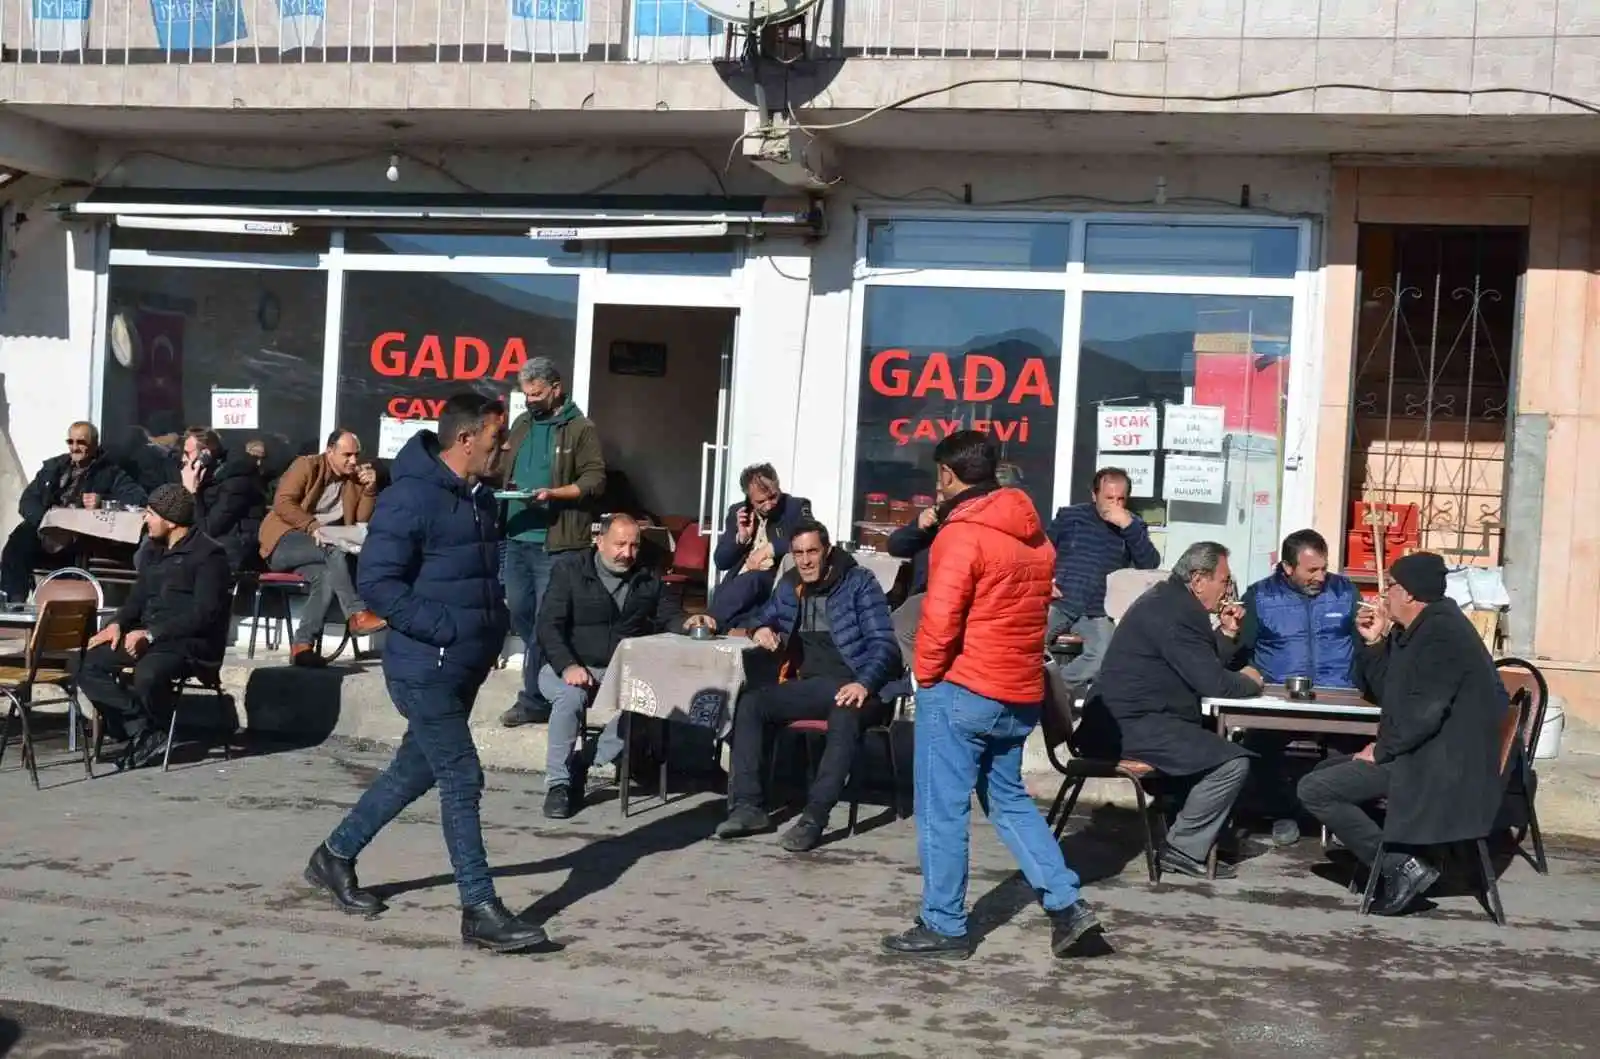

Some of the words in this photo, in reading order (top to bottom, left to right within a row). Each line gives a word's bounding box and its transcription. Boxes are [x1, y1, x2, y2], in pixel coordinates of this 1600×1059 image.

[370, 331, 529, 381] GADA
[869, 349, 1055, 405] GADA
[387, 397, 447, 424] ÇAY
[1104, 415, 1150, 428] SICAK
[889, 418, 963, 446] ÇAY
